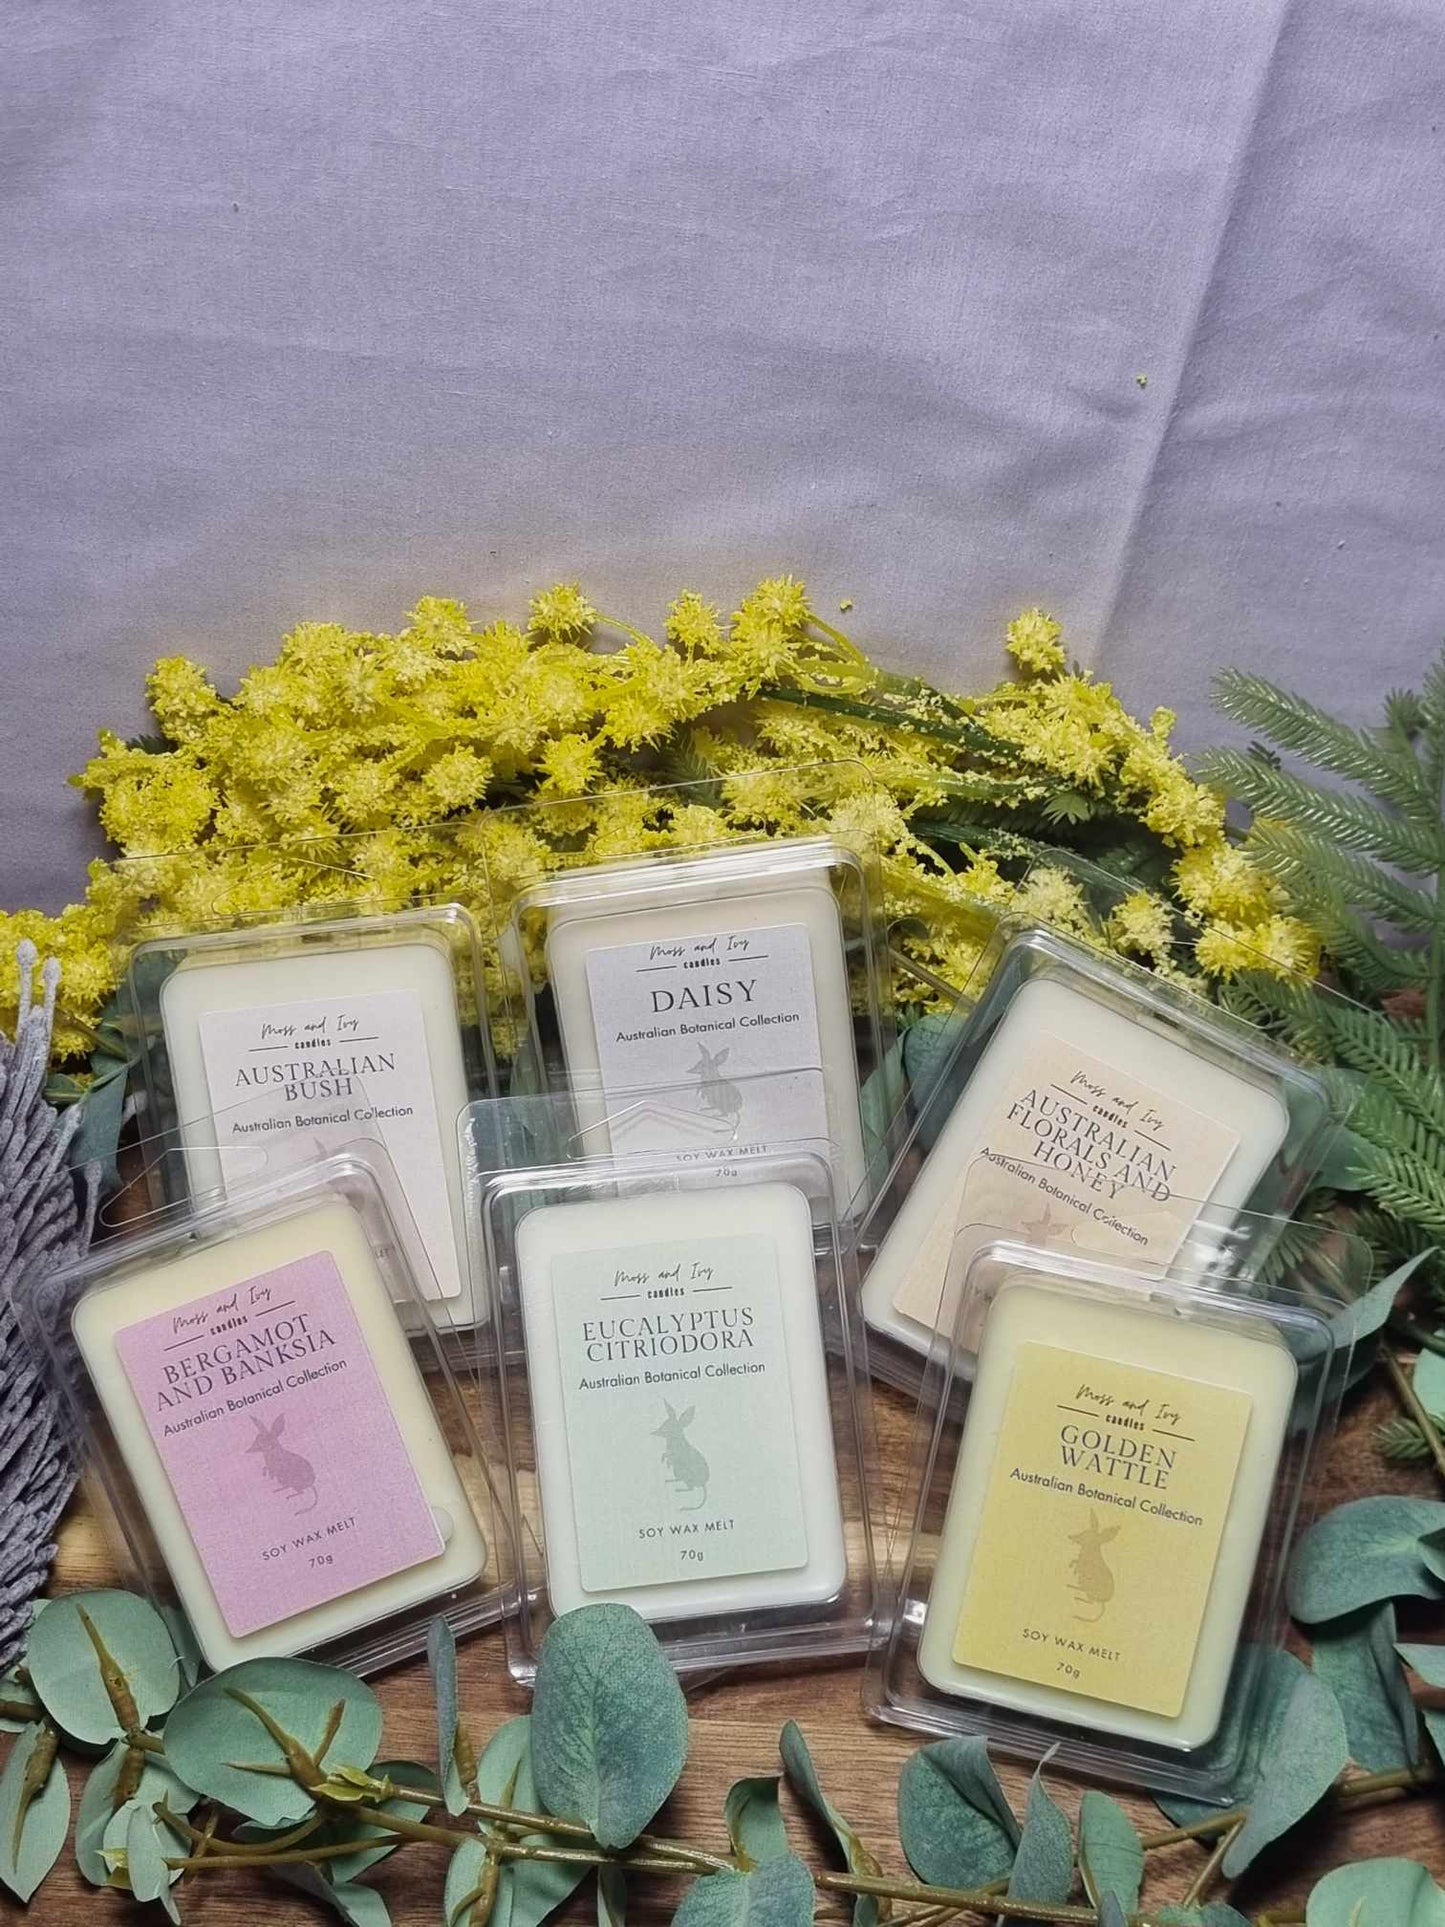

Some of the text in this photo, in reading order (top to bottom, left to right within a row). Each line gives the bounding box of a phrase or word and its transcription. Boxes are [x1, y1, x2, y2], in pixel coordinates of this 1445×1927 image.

[650, 946, 685, 960] Moss
[694, 938, 717, 952] and
[684, 958, 720, 969] candles
[651, 980, 757, 1013] DAISY
[261, 1023, 296, 1039] Moss
[304, 1017, 326, 1032] and
[616, 1013, 799, 1042] Australian Botanical Collection
[295, 1039, 331, 1049] candles
[235, 1053, 395, 1086] AUSTRALIAN
[284, 1078, 352, 1101] BUSH
[1070, 1071, 1106, 1097] Moss
[1112, 1097, 1139, 1114] and
[232, 1106, 413, 1133] Australian Botanical Collection
[1093, 1105, 1128, 1128] candles
[1020, 1090, 1176, 1181] AUSTRALIAN
[705, 1149, 733, 1159] WAX
[739, 1146, 767, 1155] MELT
[1007, 1103, 1171, 1202] FLORALS AND
[1033, 1141, 1127, 1199] HONEY
[980, 1147, 1148, 1245] Australian Botanical Collection
[614, 1270, 649, 1287] Moss
[658, 1264, 680, 1281] and
[648, 1287, 685, 1299] candles
[172, 1310, 208, 1334] Moss
[217, 1294, 238, 1313] and
[210, 1316, 248, 1335] candles
[582, 1307, 754, 1341] EUCALYPTUS
[163, 1313, 310, 1384] BERGAMOT
[587, 1329, 755, 1362] CITRIODORA
[156, 1329, 336, 1412] AND BANKSIA
[579, 1362, 765, 1390] Australian Botanical Collection
[164, 1358, 347, 1436] Australian Botanical Collection
[1076, 1384, 1113, 1406] Moss
[1122, 1398, 1150, 1416] and
[1105, 1415, 1145, 1431] candles
[1061, 1425, 1176, 1469] GOLDEN
[1061, 1446, 1169, 1489] WATTLE
[1010, 1468, 1203, 1526] Australian Botanical Collection
[262, 1517, 356, 1561] SOY WAX MELT
[639, 1520, 735, 1539] SOY WAX MELT
[308, 1554, 334, 1569] 70g
[680, 1550, 703, 1561] 70g
[1023, 1628, 1121, 1662] SOY WAX MELT
[1056, 1662, 1080, 1679] 70g
